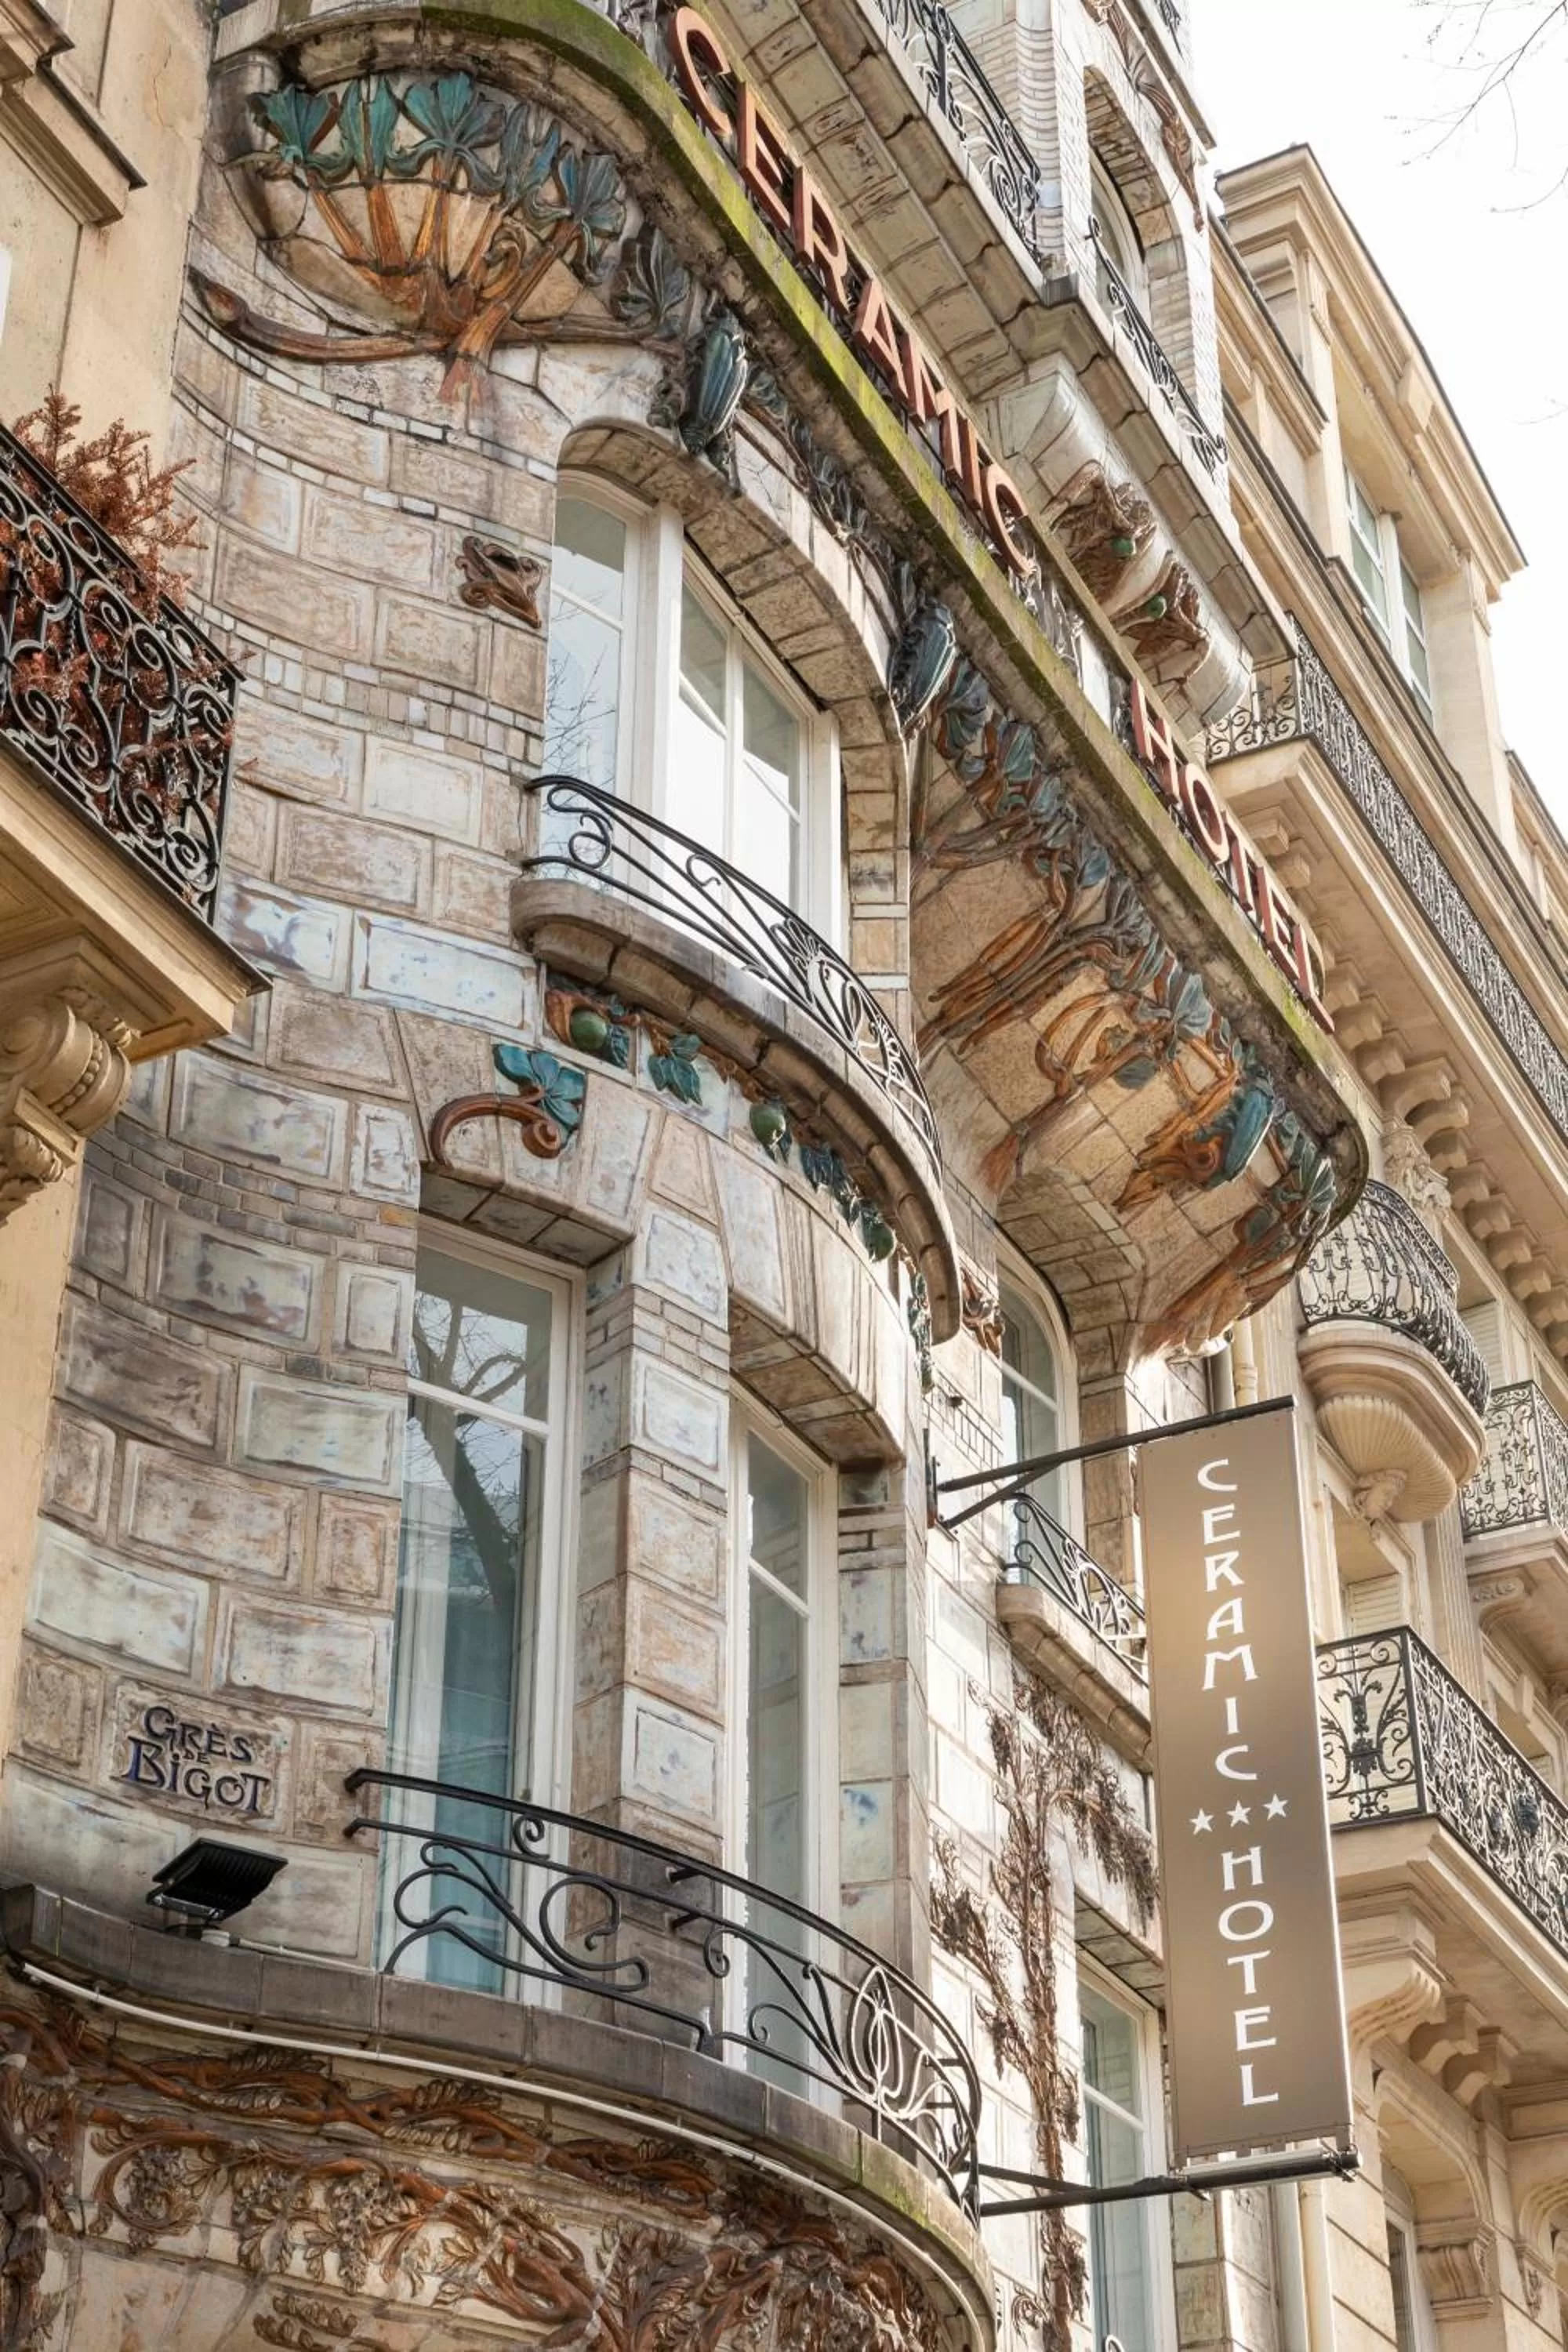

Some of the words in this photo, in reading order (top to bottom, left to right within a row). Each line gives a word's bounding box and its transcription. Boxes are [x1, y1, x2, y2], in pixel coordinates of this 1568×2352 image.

[668, 5, 1039, 578] CERAMIC
[1131, 677, 1335, 1034] HOTEL
[183, 1746, 210, 1764] DE
[1197, 1458, 1258, 1780] CERAMIC
[1218, 1846, 1279, 2106] HOTEL
